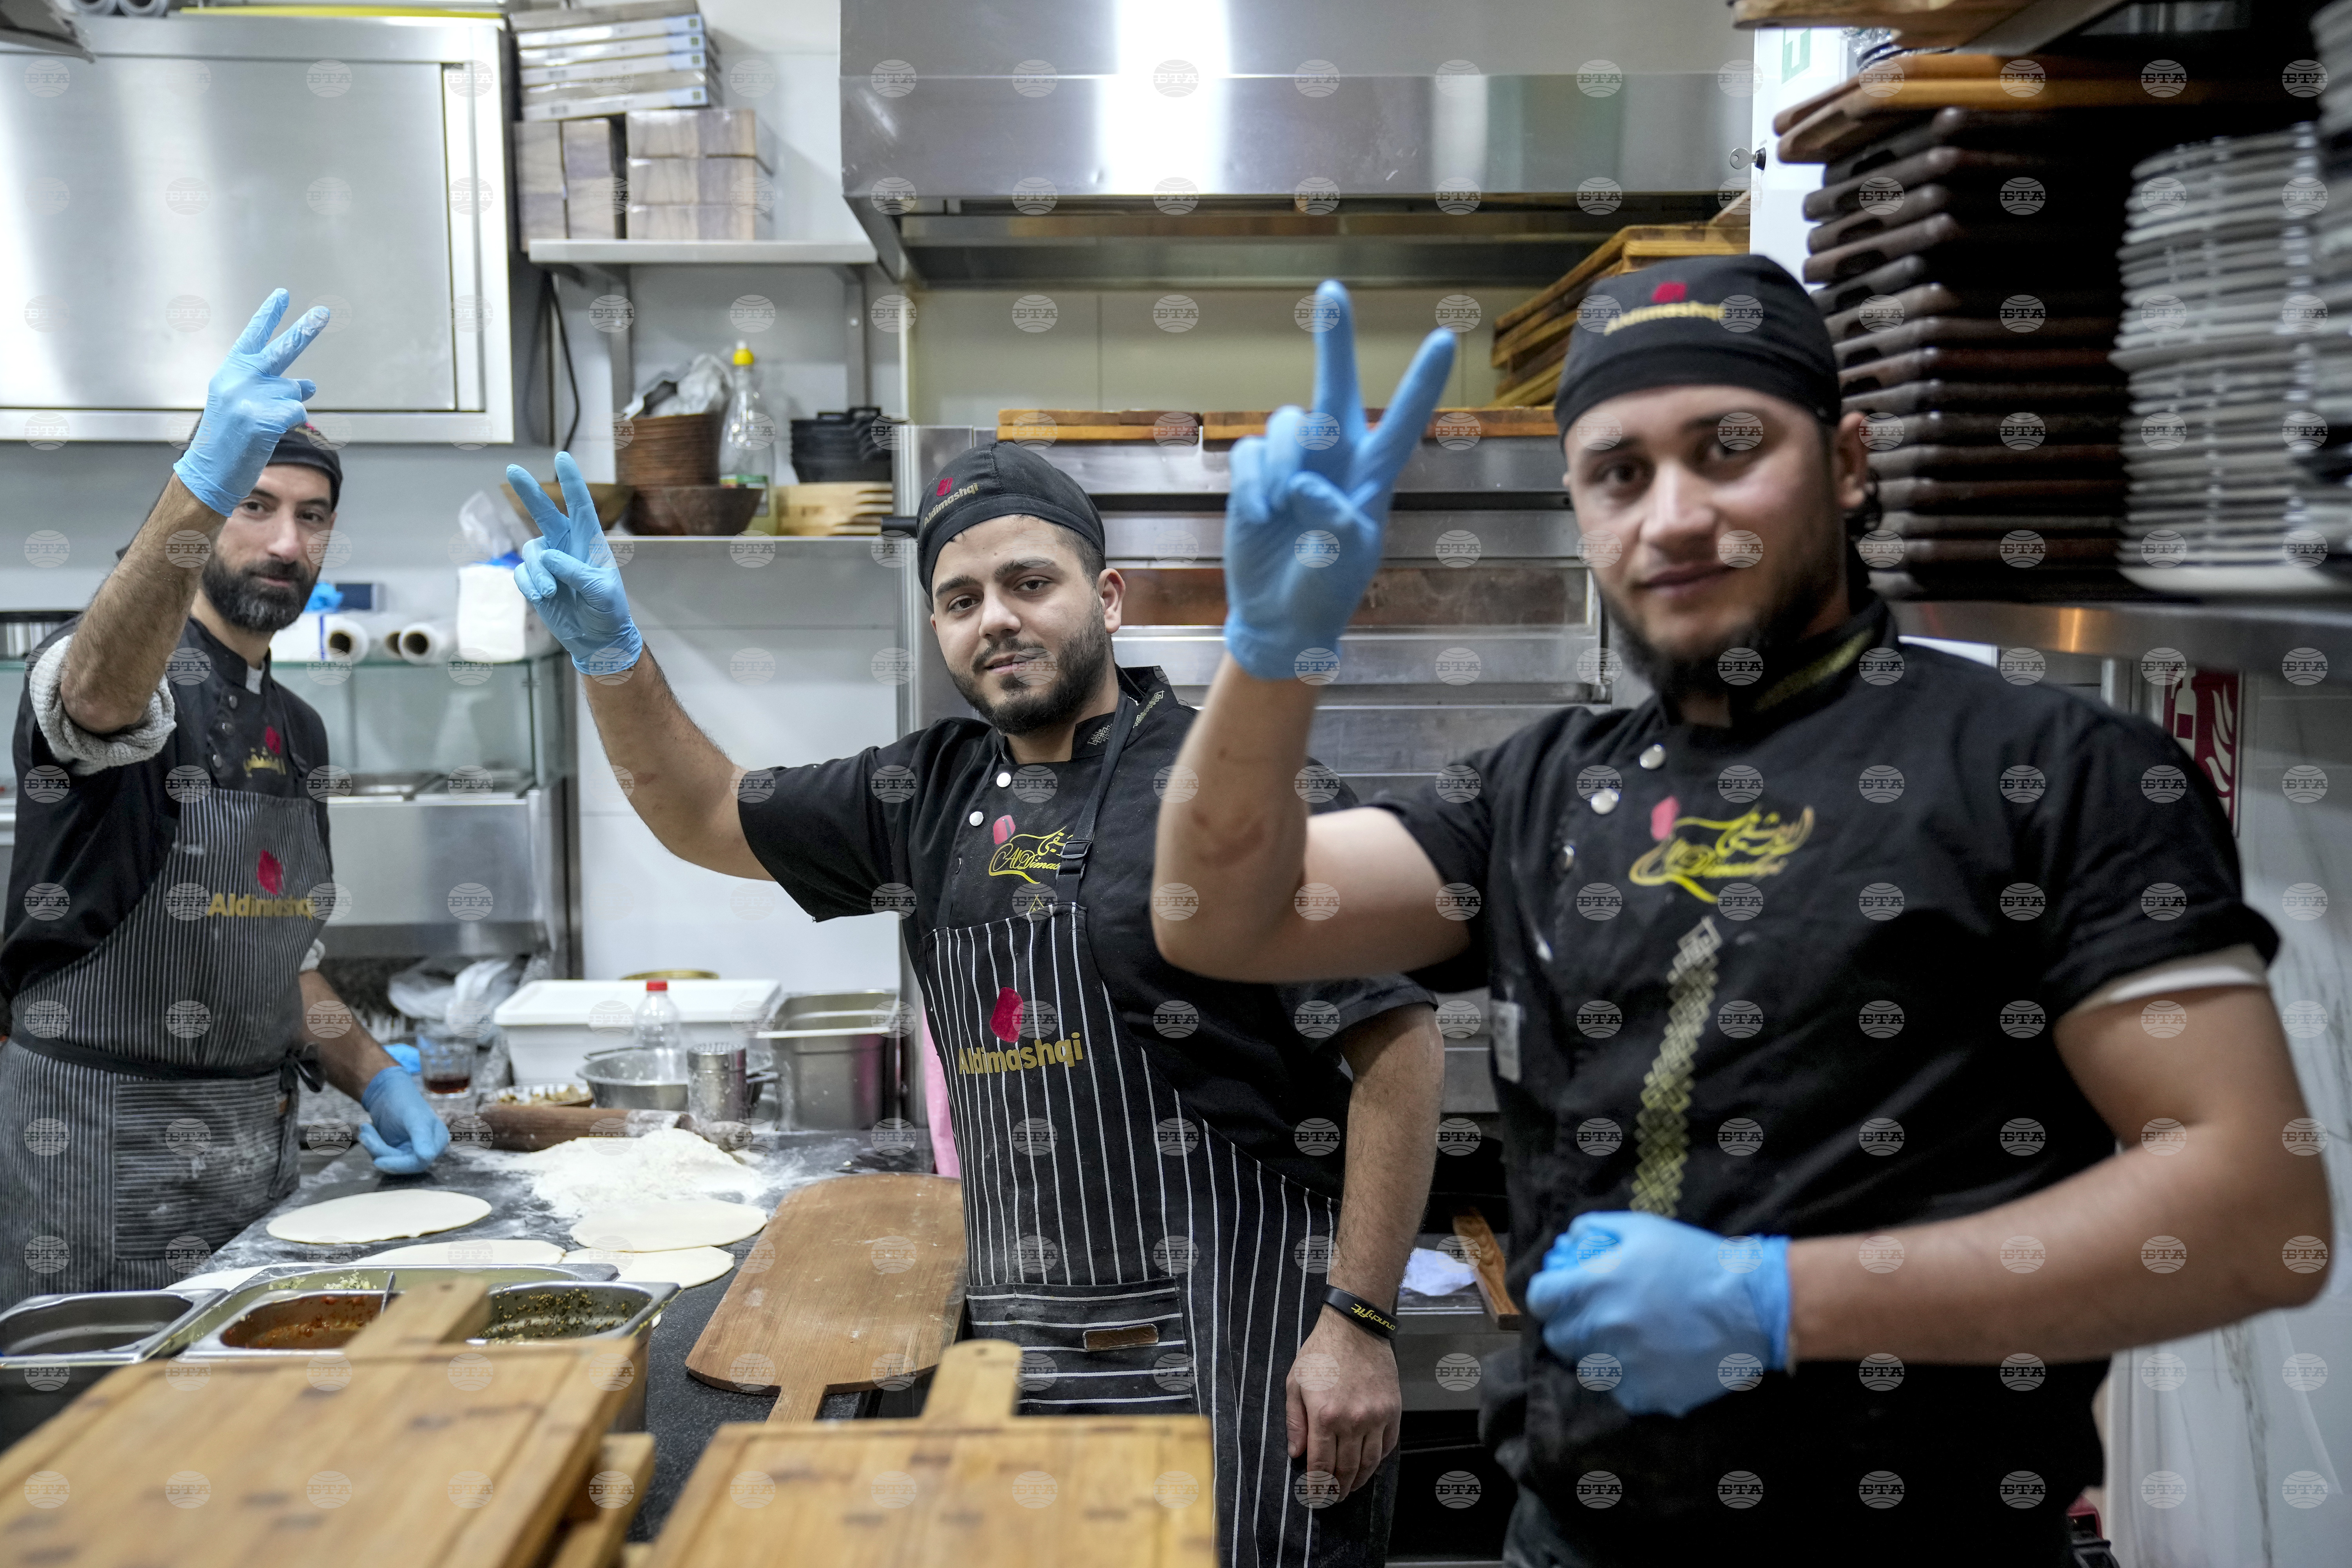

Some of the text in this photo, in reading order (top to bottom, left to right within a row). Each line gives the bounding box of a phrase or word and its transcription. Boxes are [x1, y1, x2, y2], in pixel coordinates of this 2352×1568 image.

[923, 483, 978, 528] Aldimashqi
[206, 892, 316, 920] Aldimhq
[958, 1032, 1083, 1074] Aldimashqi
